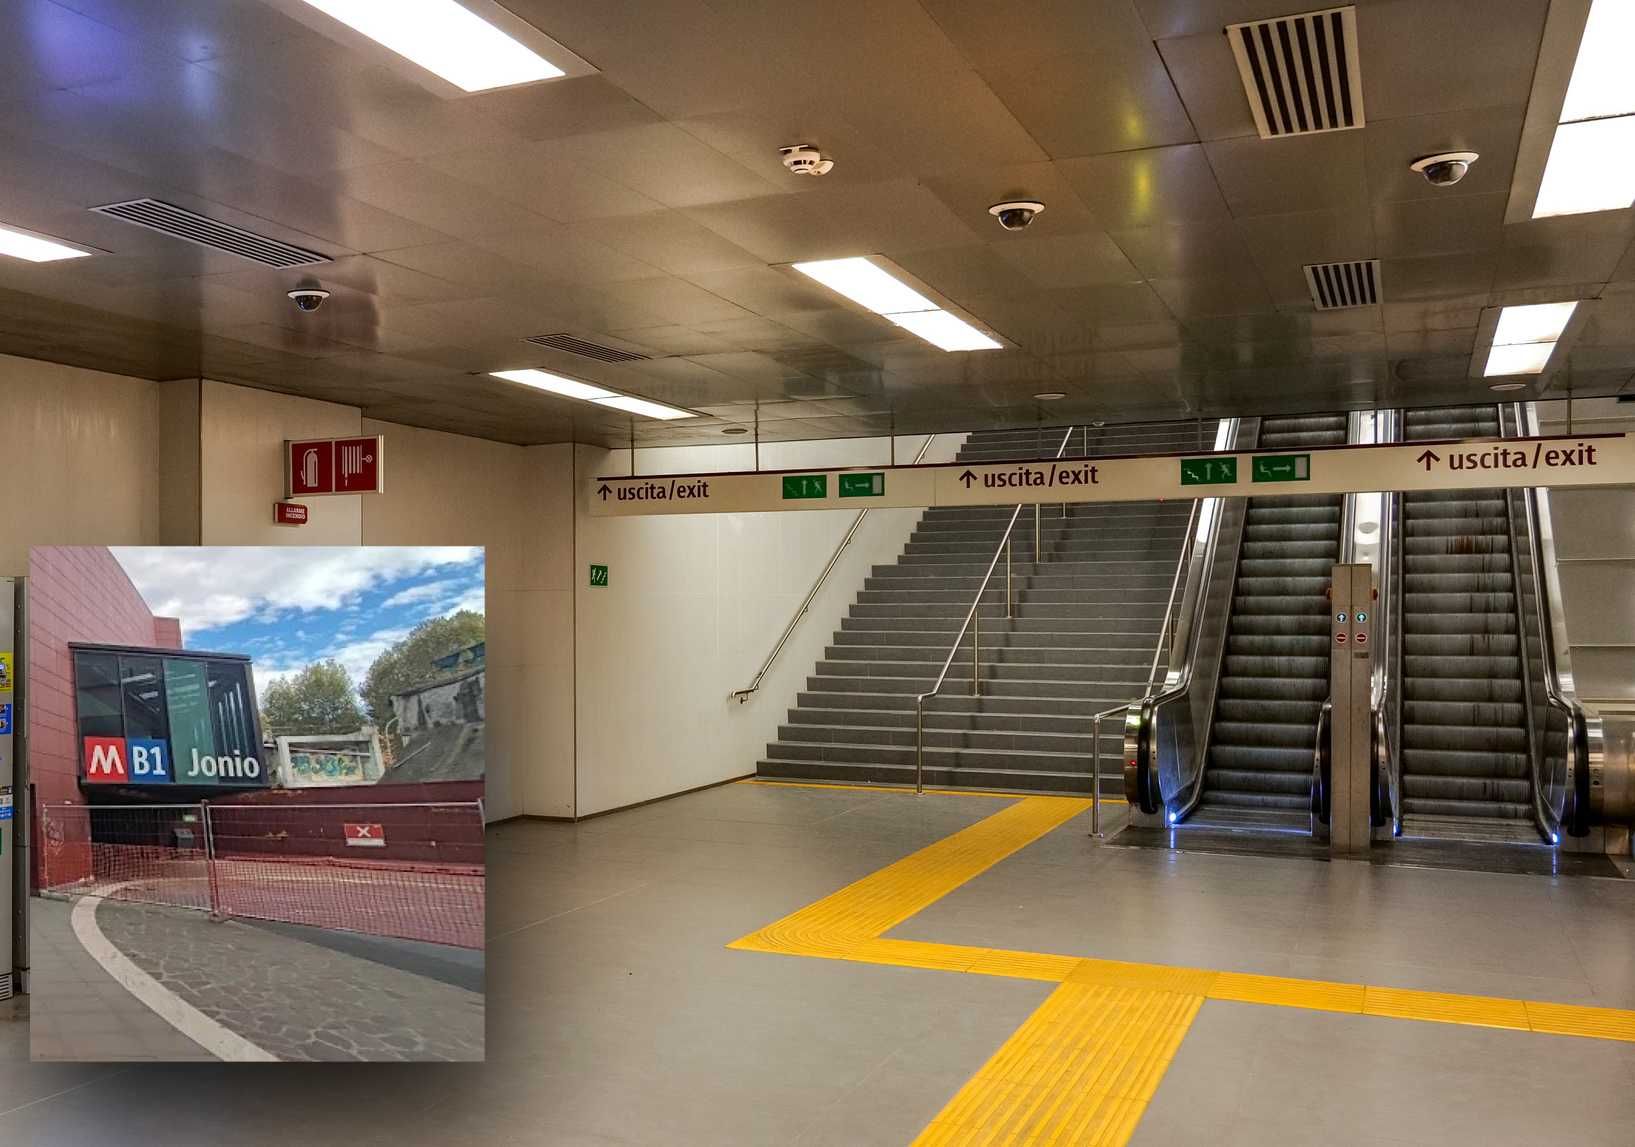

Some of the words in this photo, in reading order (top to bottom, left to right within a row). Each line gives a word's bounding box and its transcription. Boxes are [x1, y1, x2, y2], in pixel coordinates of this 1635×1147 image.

[1449, 443, 1597, 470] uscita/exit
[983, 464, 1099, 488] uscita/exit
[617, 479, 709, 501] uscita/exit
[89, 744, 125, 774] M
[132, 746, 167, 776] B1
[187, 748, 260, 778] Jonio
